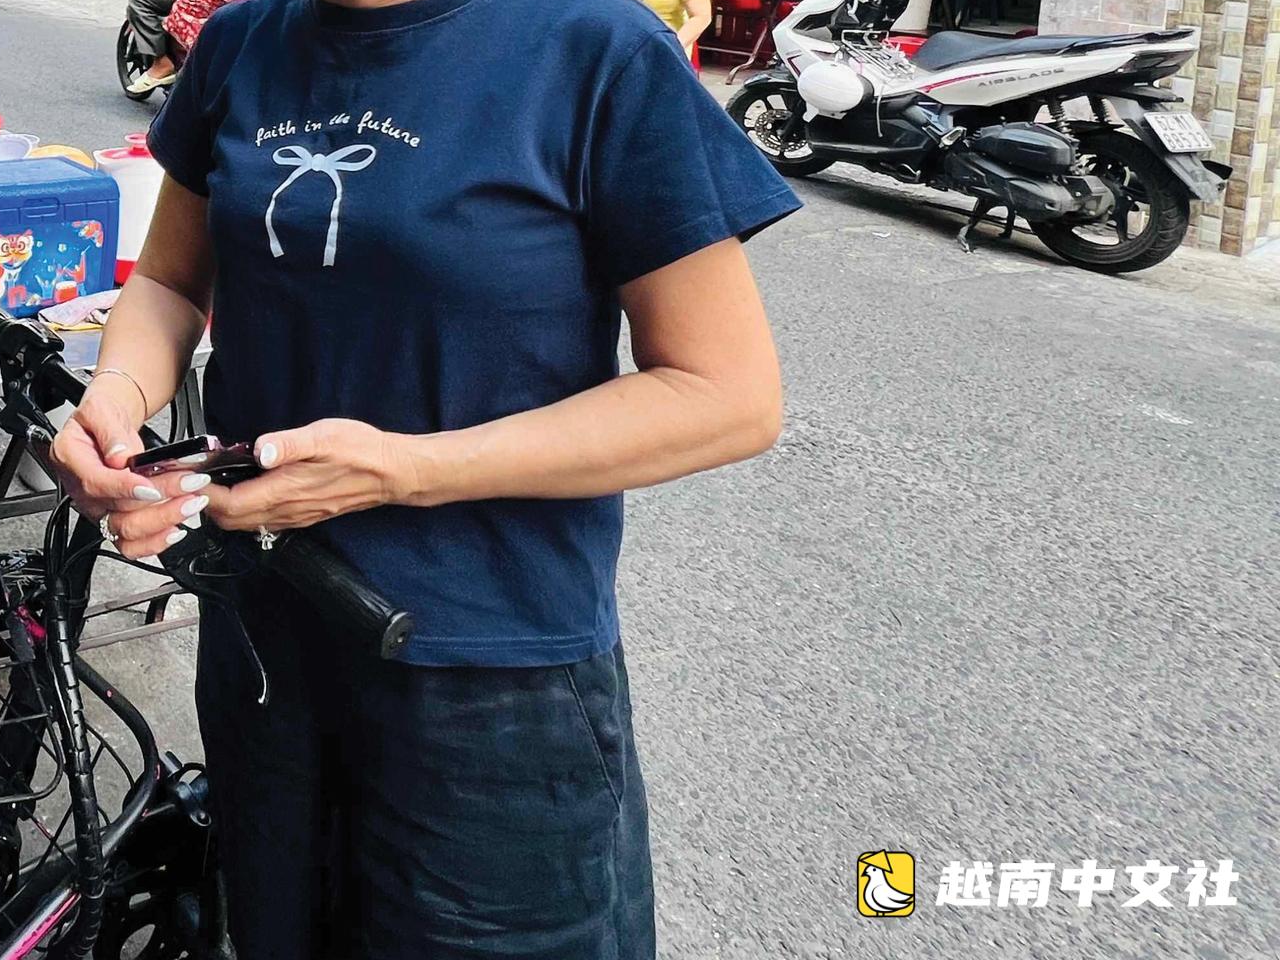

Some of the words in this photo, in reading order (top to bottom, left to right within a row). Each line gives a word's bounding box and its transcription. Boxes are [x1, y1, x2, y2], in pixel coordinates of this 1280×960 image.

[255, 120, 295, 147] faith
[304, 121, 322, 132] in
[358, 110, 421, 148] future
